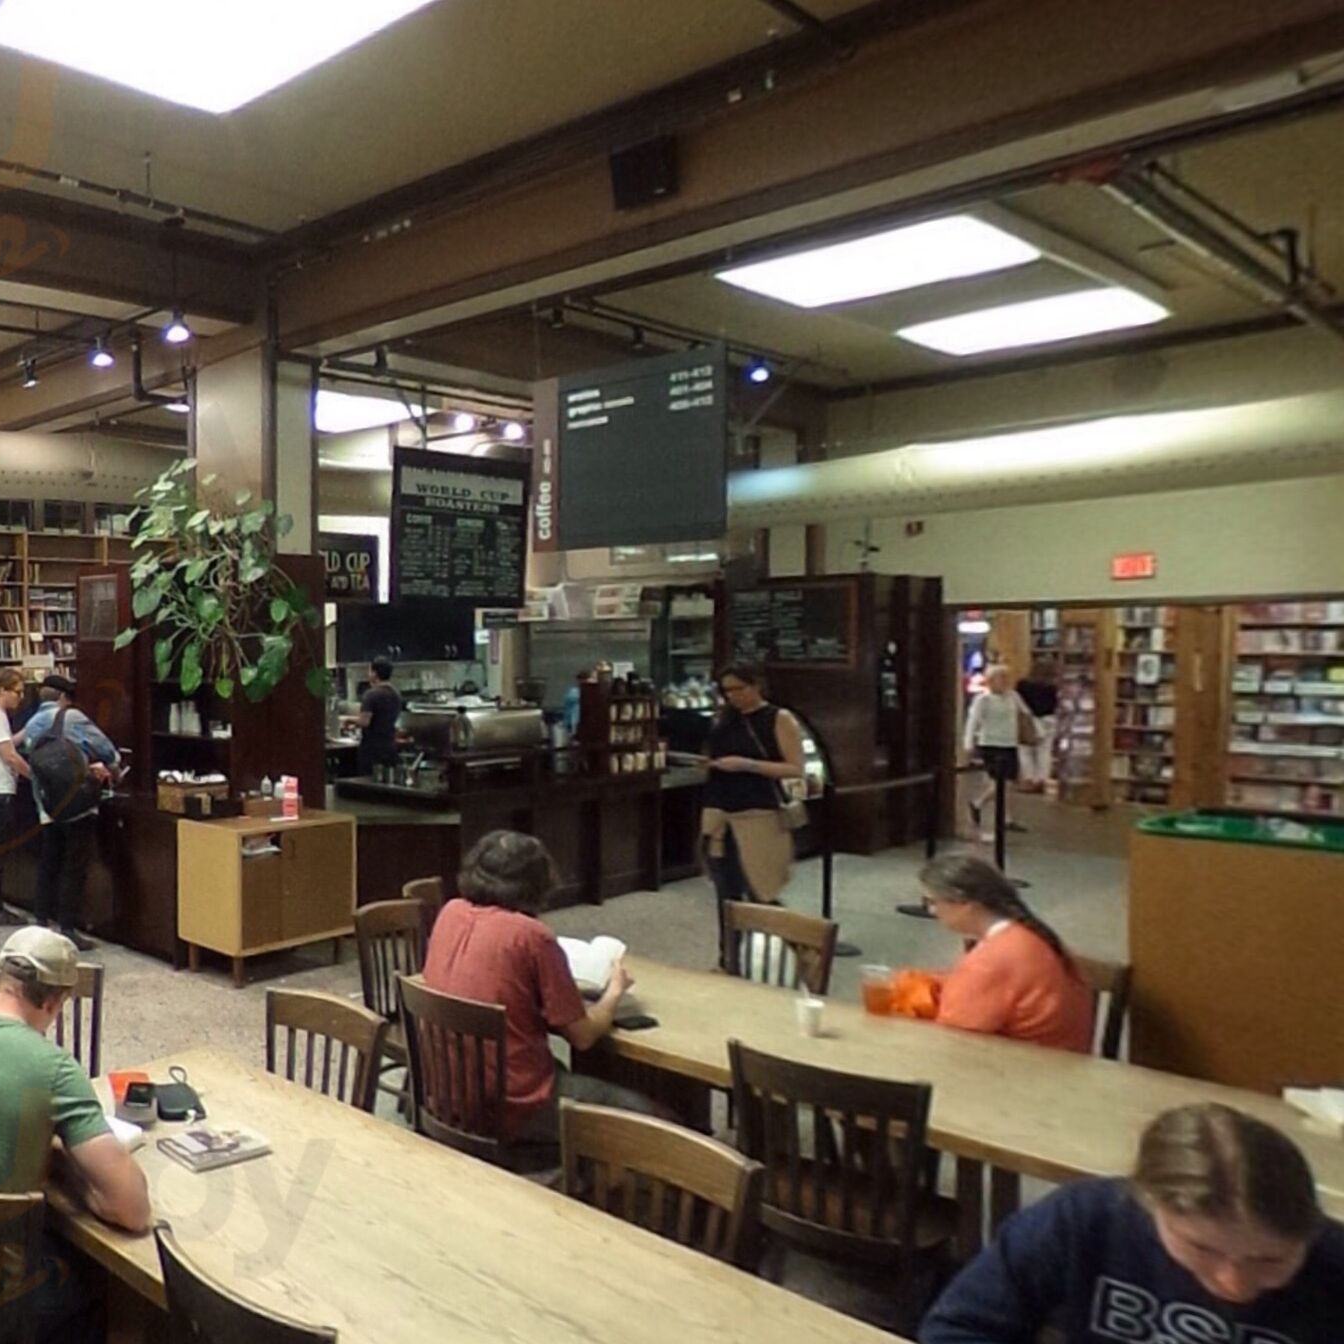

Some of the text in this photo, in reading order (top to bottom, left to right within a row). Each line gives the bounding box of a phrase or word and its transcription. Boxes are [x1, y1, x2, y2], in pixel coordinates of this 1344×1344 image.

[416, 483, 510, 502] WORLD CUP
[536, 482, 552, 540] coffee
[345, 552, 371, 573] CUP
[1090, 1275, 1299, 1344] BS
